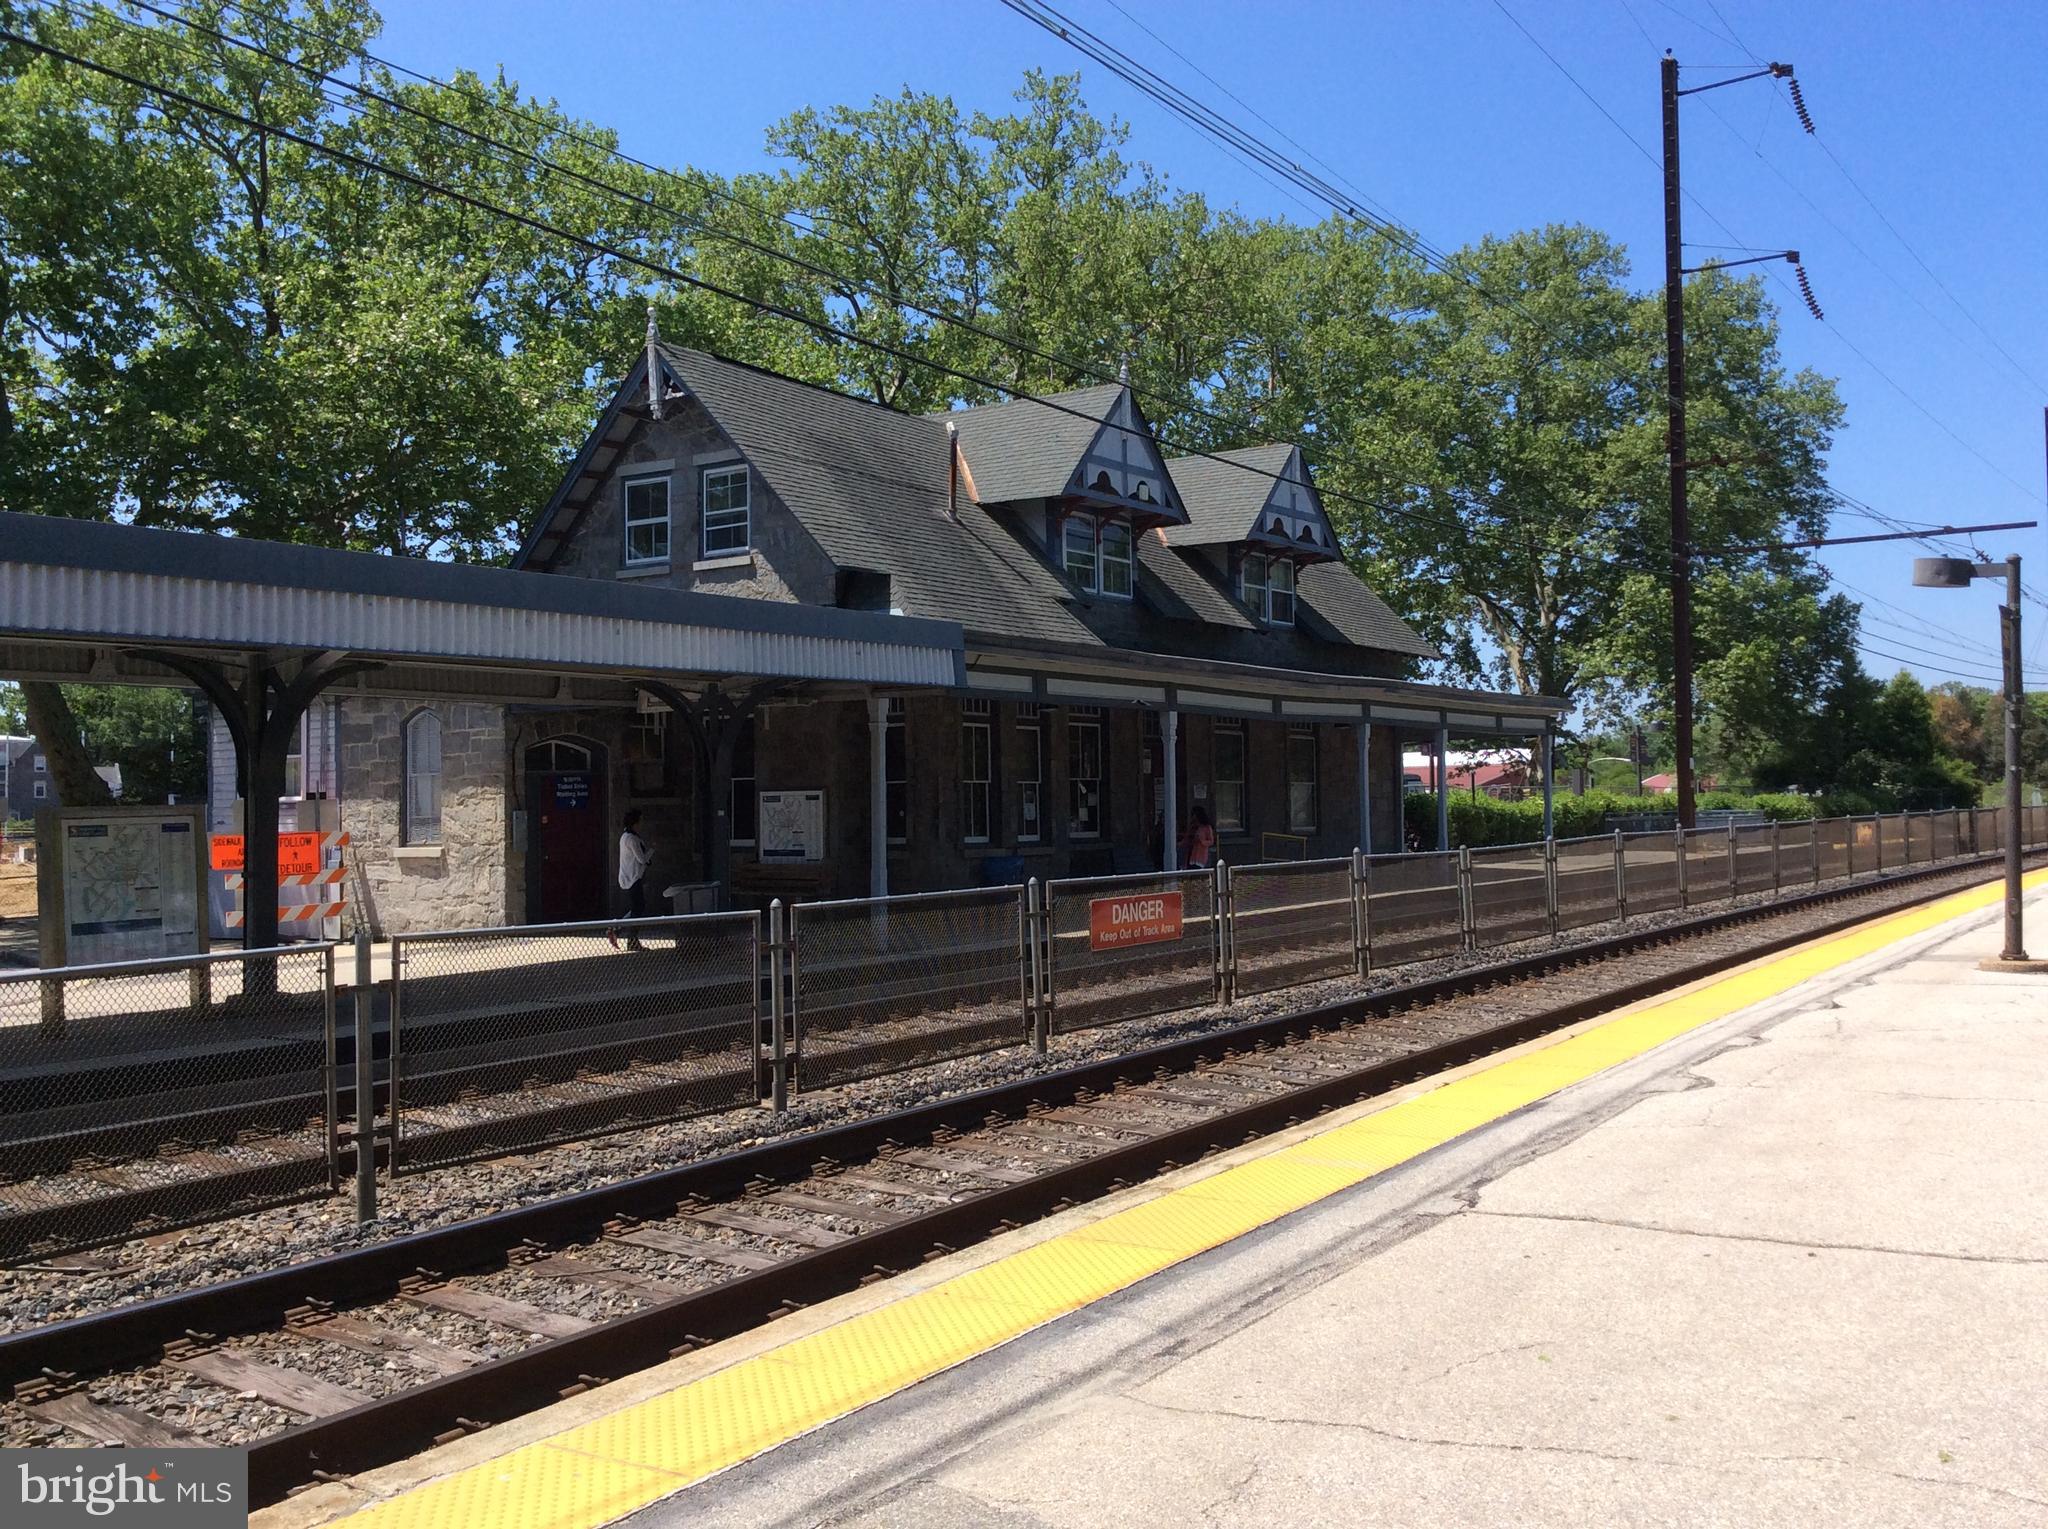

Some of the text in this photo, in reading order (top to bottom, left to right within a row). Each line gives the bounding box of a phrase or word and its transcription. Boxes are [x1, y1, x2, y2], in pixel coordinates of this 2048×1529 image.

[280, 836, 312, 847] FOLLOW
[280, 863, 312, 873] DETOUR
[1112, 899, 1164, 925] DANGER
[1100, 924, 1175, 943] Keep Out of Track Area
